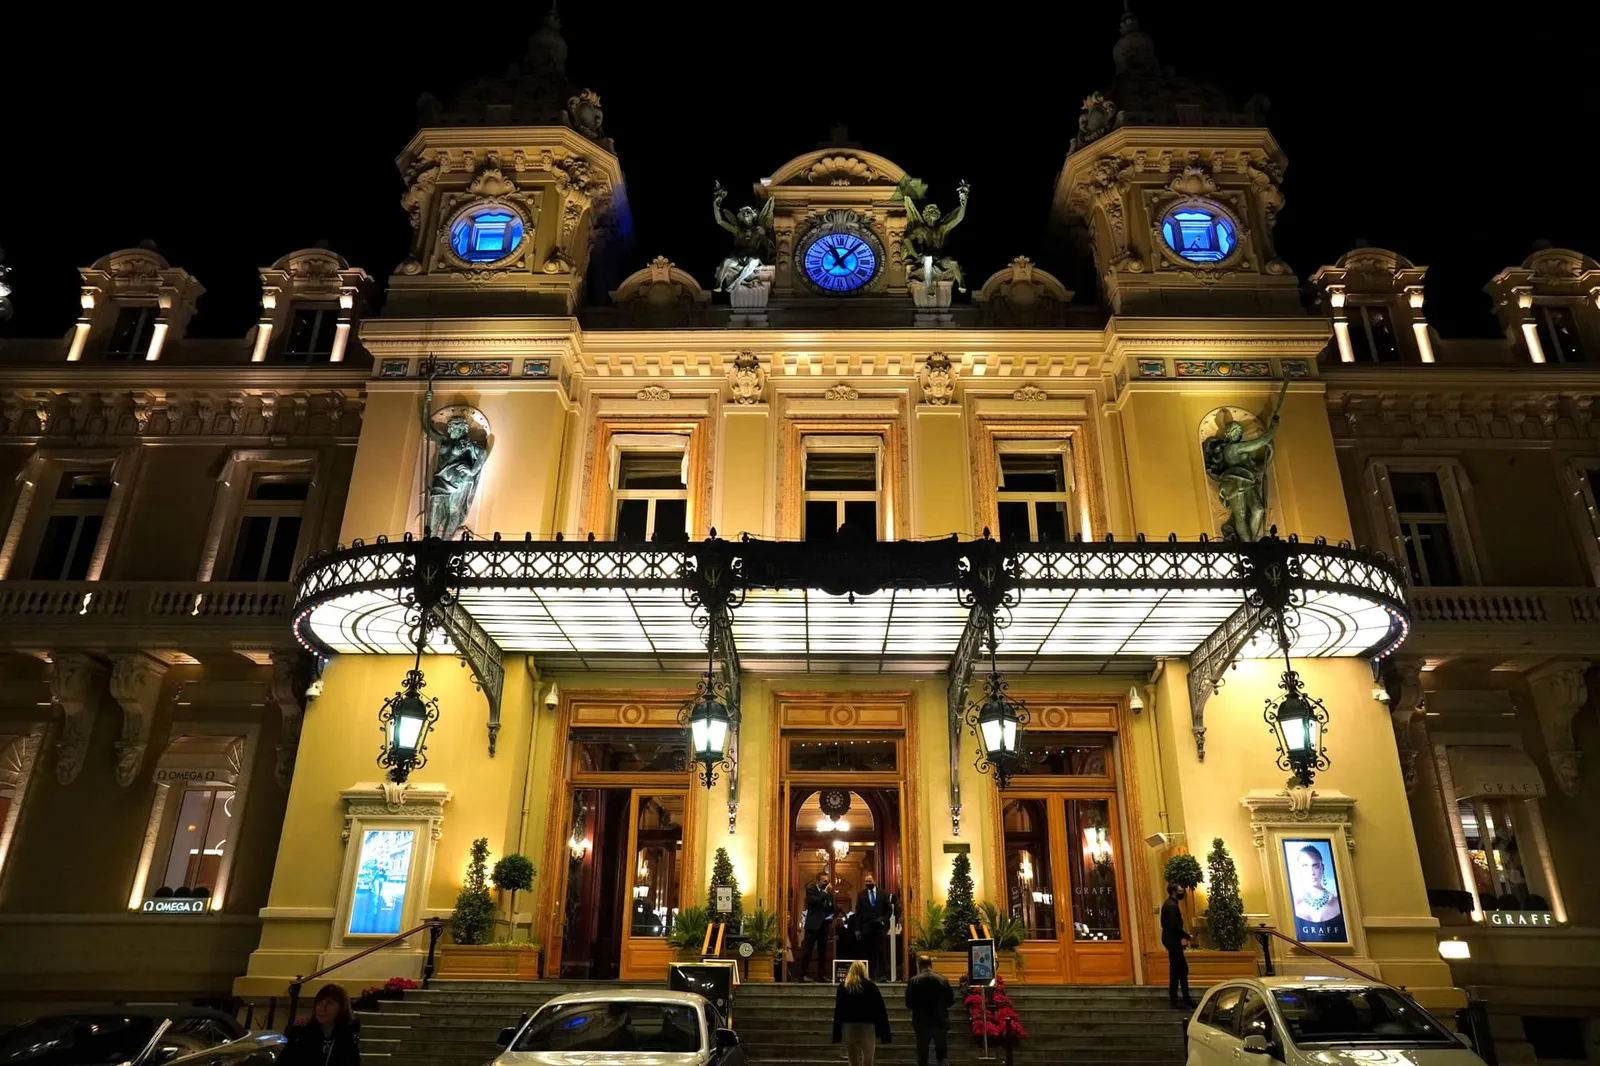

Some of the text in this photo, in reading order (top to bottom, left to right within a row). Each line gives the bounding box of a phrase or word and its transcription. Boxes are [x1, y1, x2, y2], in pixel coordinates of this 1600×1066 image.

[168, 771, 203, 780] OMEGA
[1483, 783, 1541, 794] GRAFF
[1075, 886, 1113, 895] GRAFF
[155, 902, 190, 911] OMEGA
[1491, 913, 1551, 925] GRAFF
[1302, 926, 1339, 934] GRAFF
